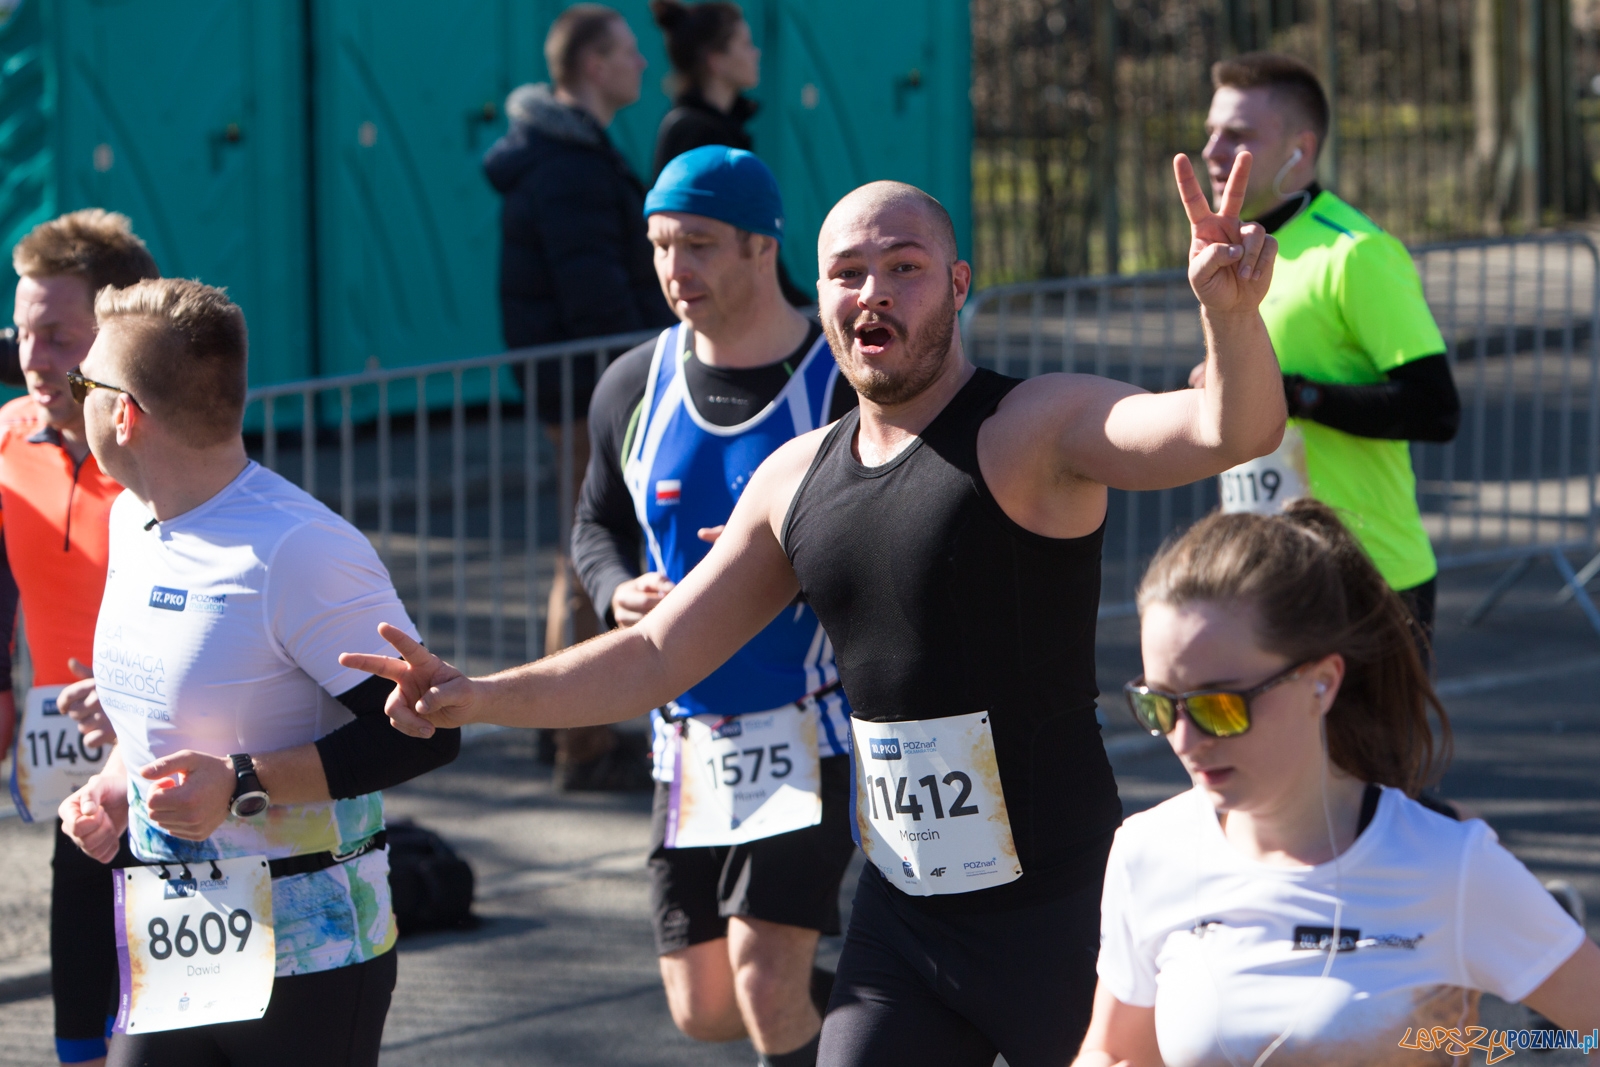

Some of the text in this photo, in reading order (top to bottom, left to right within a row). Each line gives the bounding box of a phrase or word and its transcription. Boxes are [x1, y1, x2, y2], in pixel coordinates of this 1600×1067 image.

[147, 707, 170, 722] 2016
[707, 743, 792, 789] 1575
[866, 770, 979, 821] 11412
[899, 828, 940, 842] Marcin
[930, 866, 947, 878] 4F
[148, 908, 252, 960] 8609
[187, 963, 221, 977] Dawid
